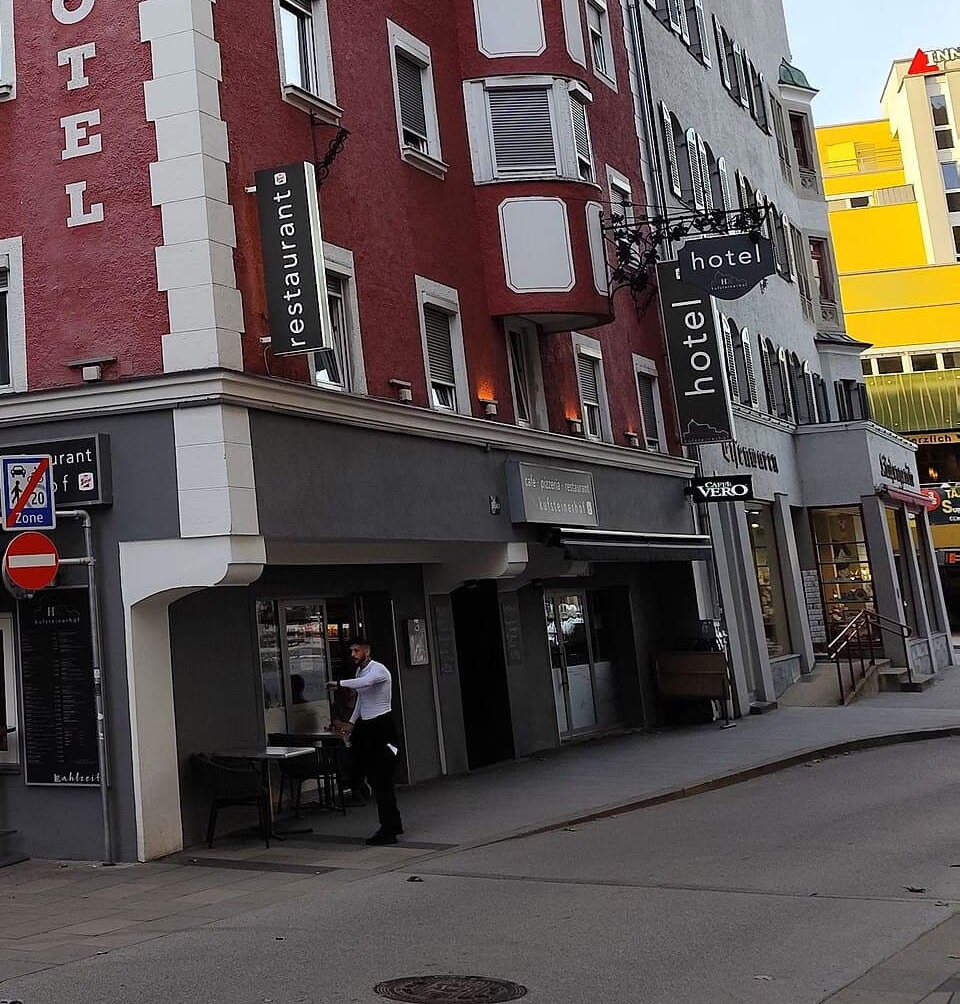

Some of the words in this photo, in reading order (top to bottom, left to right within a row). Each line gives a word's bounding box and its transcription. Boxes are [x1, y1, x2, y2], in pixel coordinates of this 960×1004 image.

[691, 243, 761, 271] hotel
[273, 189, 307, 347] restaurant
[671, 299, 716, 396] hotel
[904, 434, 952, 444] erzlich
[697, 484, 749, 497] VERO
[31, 491, 45, 505] 20
[15, 512, 44, 524] Zone
